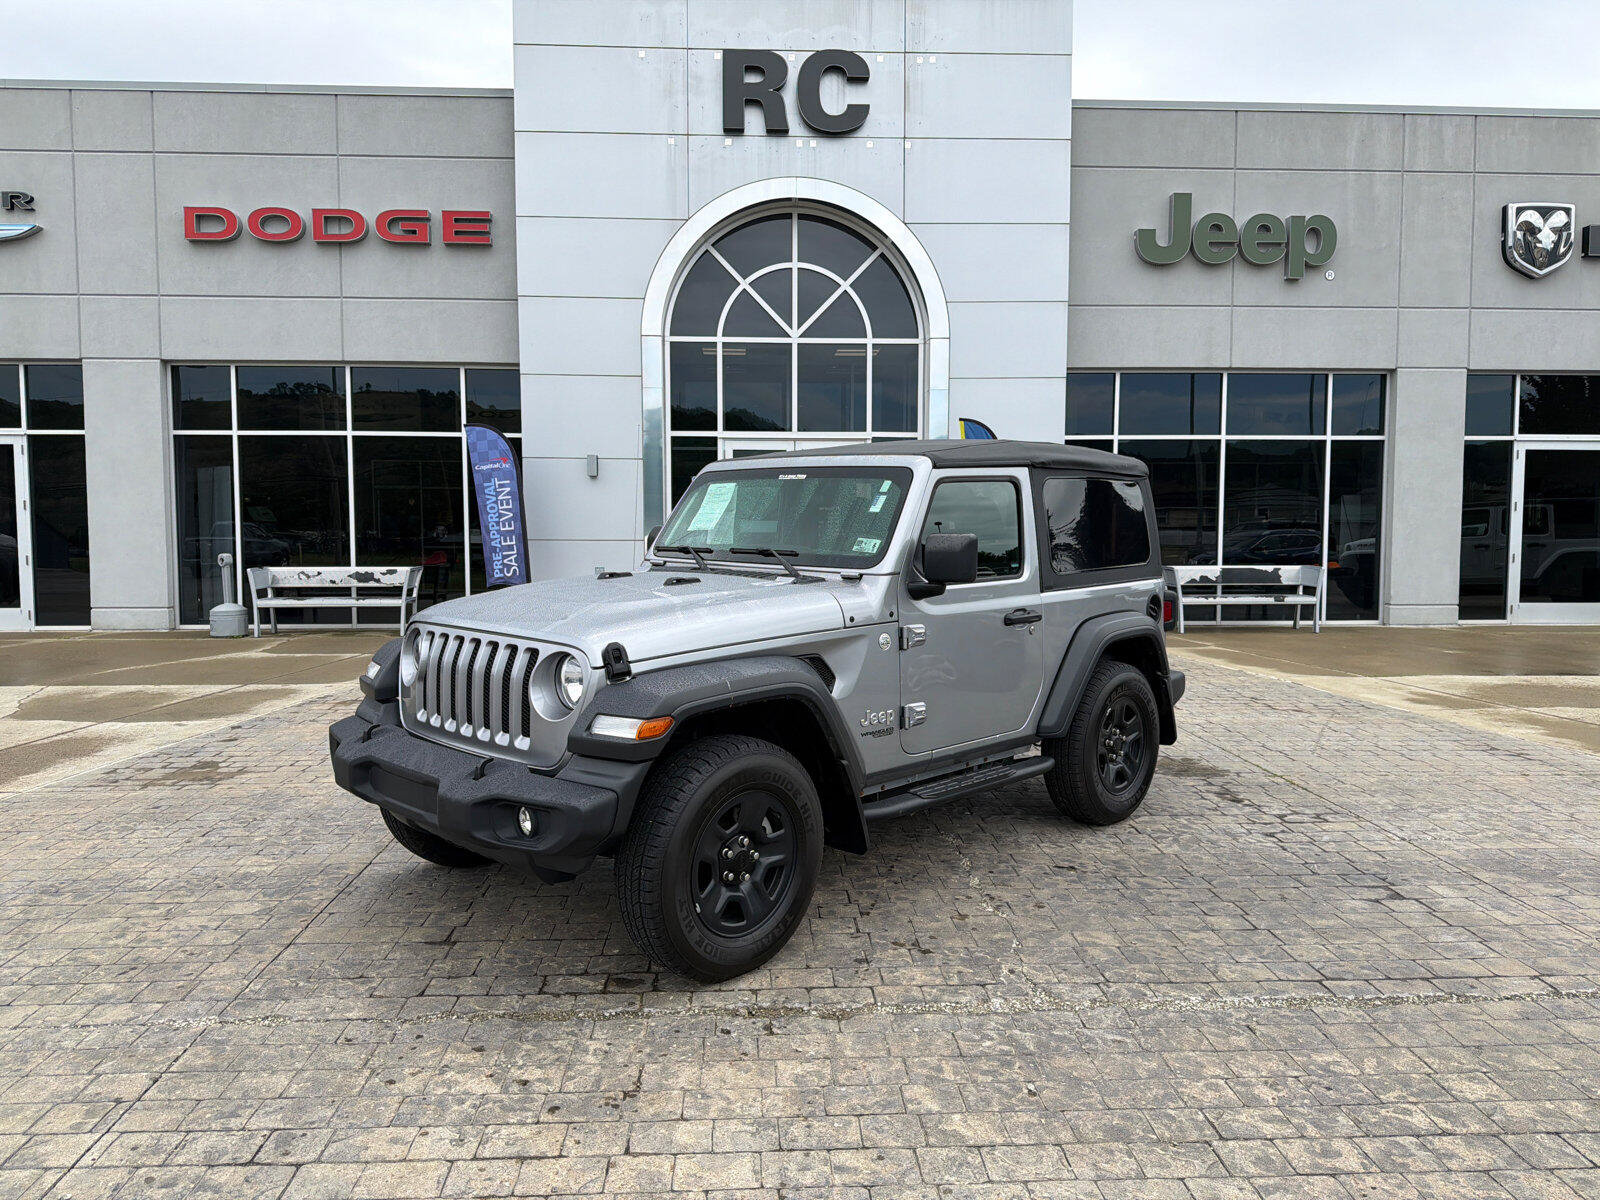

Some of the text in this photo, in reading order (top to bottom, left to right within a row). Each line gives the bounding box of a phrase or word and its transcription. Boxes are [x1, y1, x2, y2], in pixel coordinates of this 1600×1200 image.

[722, 48, 871, 134] RC
[183, 206, 493, 247] DODGE
[1134, 192, 1338, 281] Jeep
[483, 477, 504, 578] PRE-APPROVAL
[494, 477, 519, 577] SALE EVENT
[860, 709, 895, 727] Jeep
